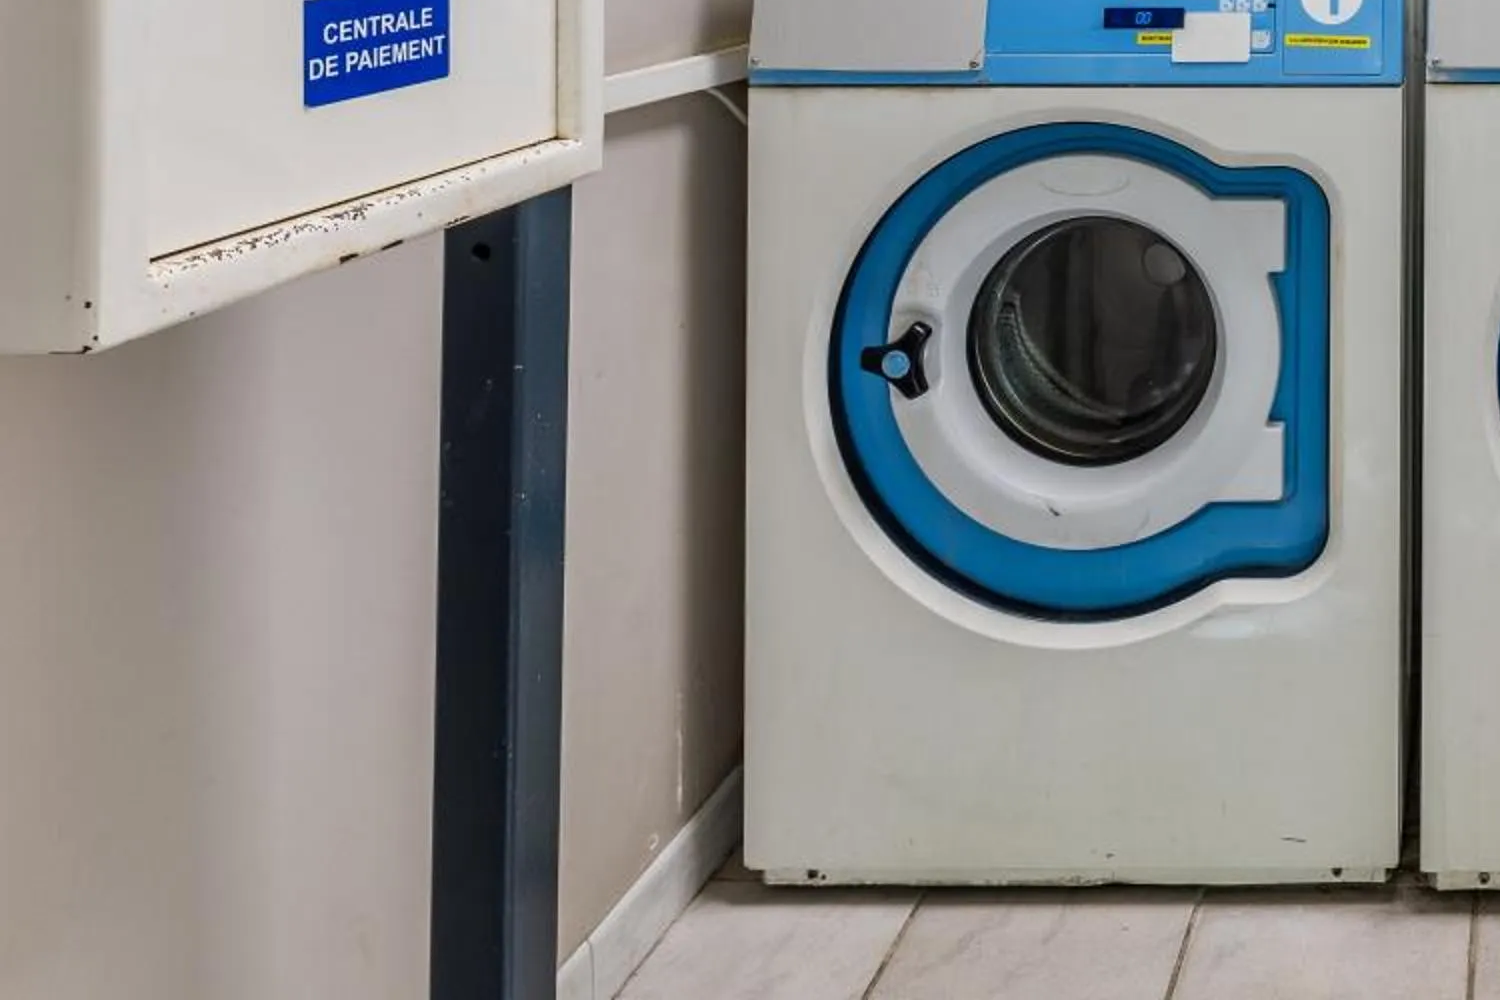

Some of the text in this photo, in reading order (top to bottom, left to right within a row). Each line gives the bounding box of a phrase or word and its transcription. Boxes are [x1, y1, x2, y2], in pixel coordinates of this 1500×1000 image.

[323, 7, 433, 45] CENTRALE
[309, 34, 446, 81] DE PAIEMENT
